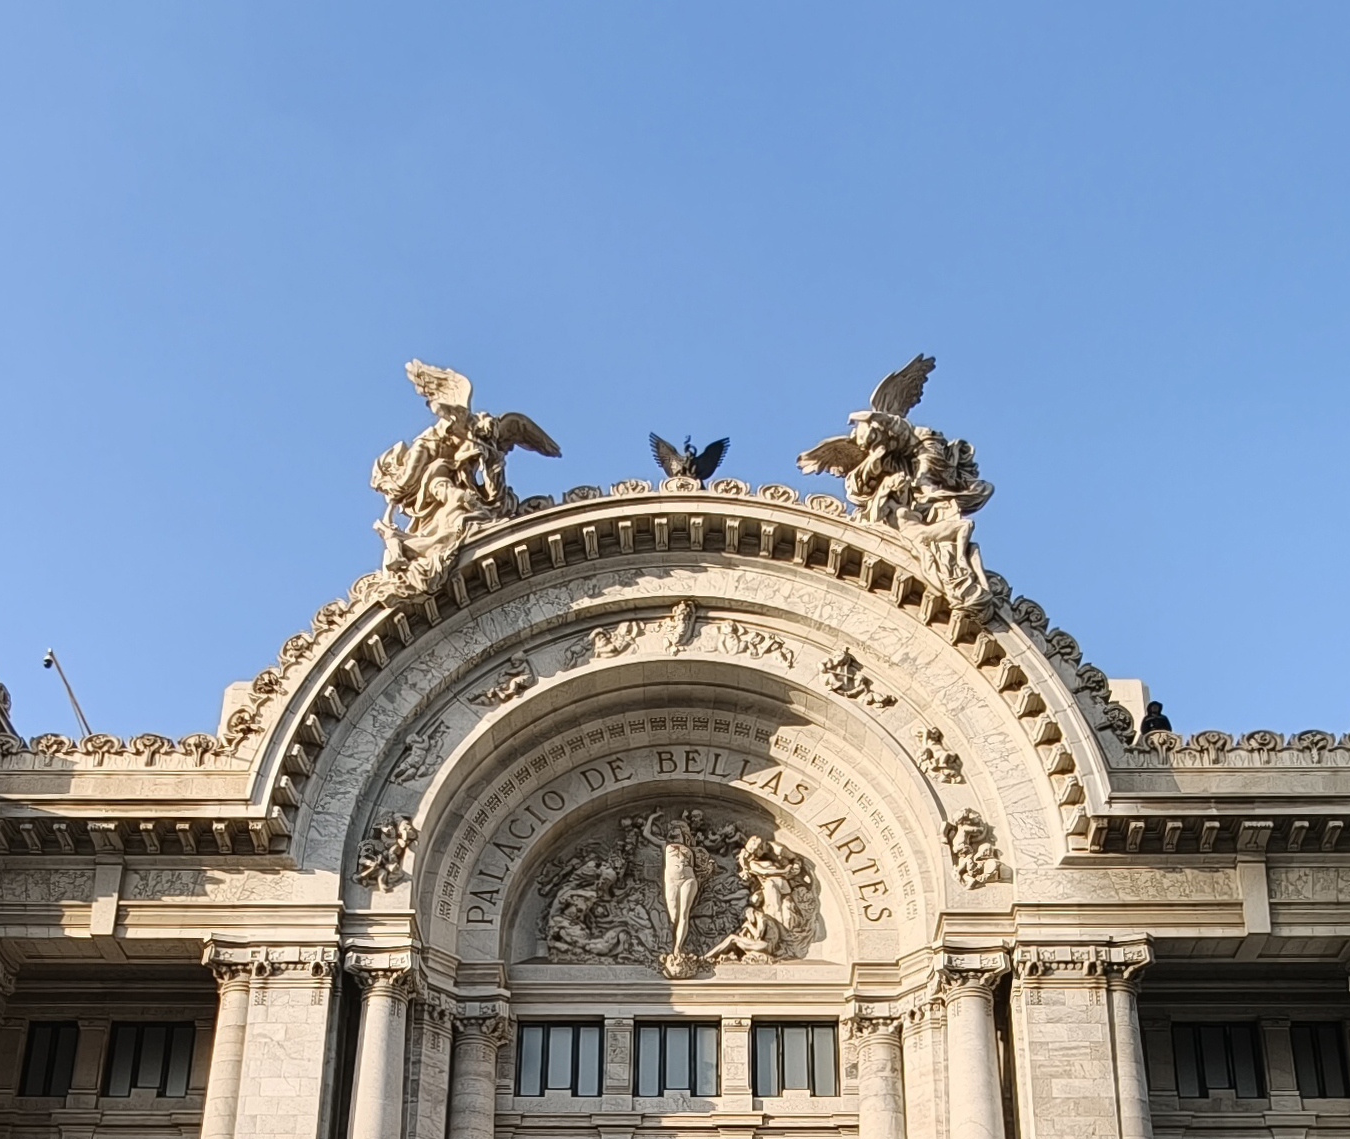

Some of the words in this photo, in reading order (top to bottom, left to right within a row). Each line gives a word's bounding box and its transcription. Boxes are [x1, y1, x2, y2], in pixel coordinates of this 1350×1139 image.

[466, 789, 566, 925] PALACIO
[579, 756, 634, 793] DE
[656, 749, 811, 806] BELLAS
[818, 815, 893, 924] ARTES
